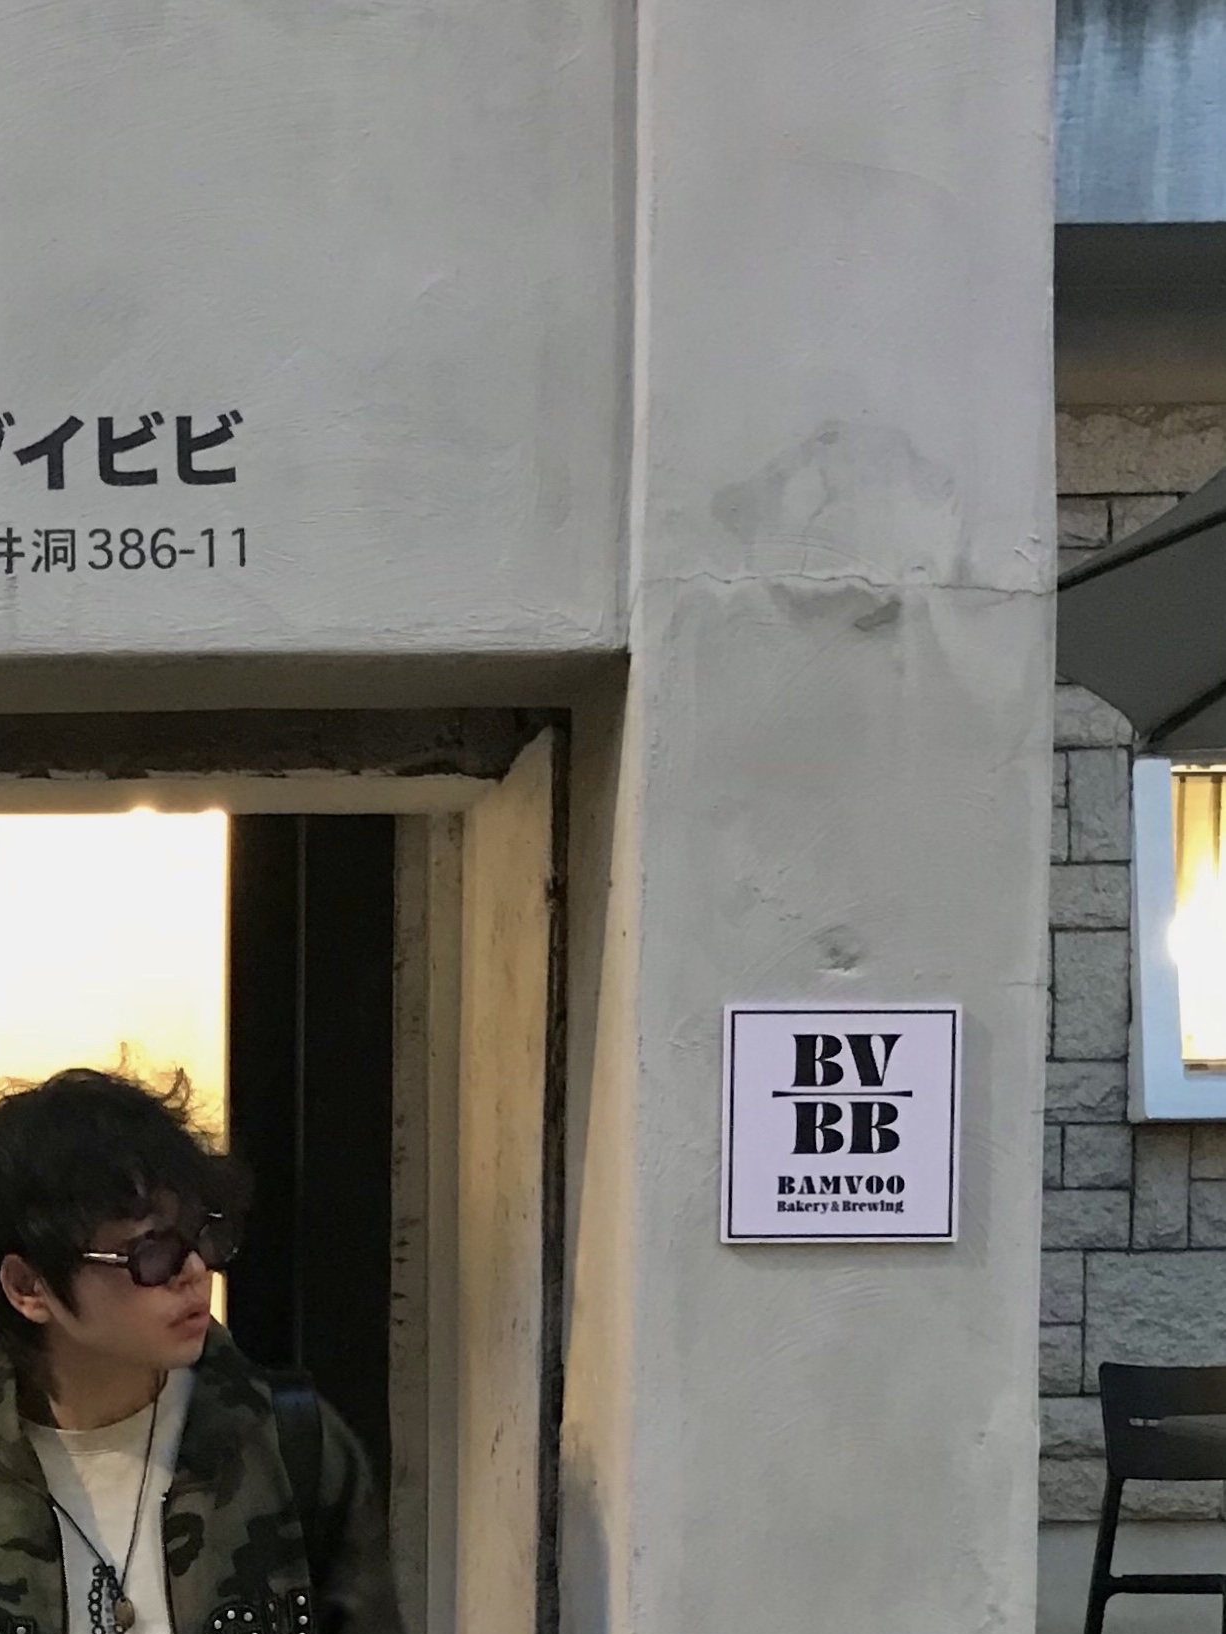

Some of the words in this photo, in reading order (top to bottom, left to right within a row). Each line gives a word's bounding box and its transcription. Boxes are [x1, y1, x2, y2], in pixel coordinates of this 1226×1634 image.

[791, 1034, 903, 1087] BV
[791, 1101, 900, 1155] BB
[777, 1175, 906, 1195] BAMVOO
